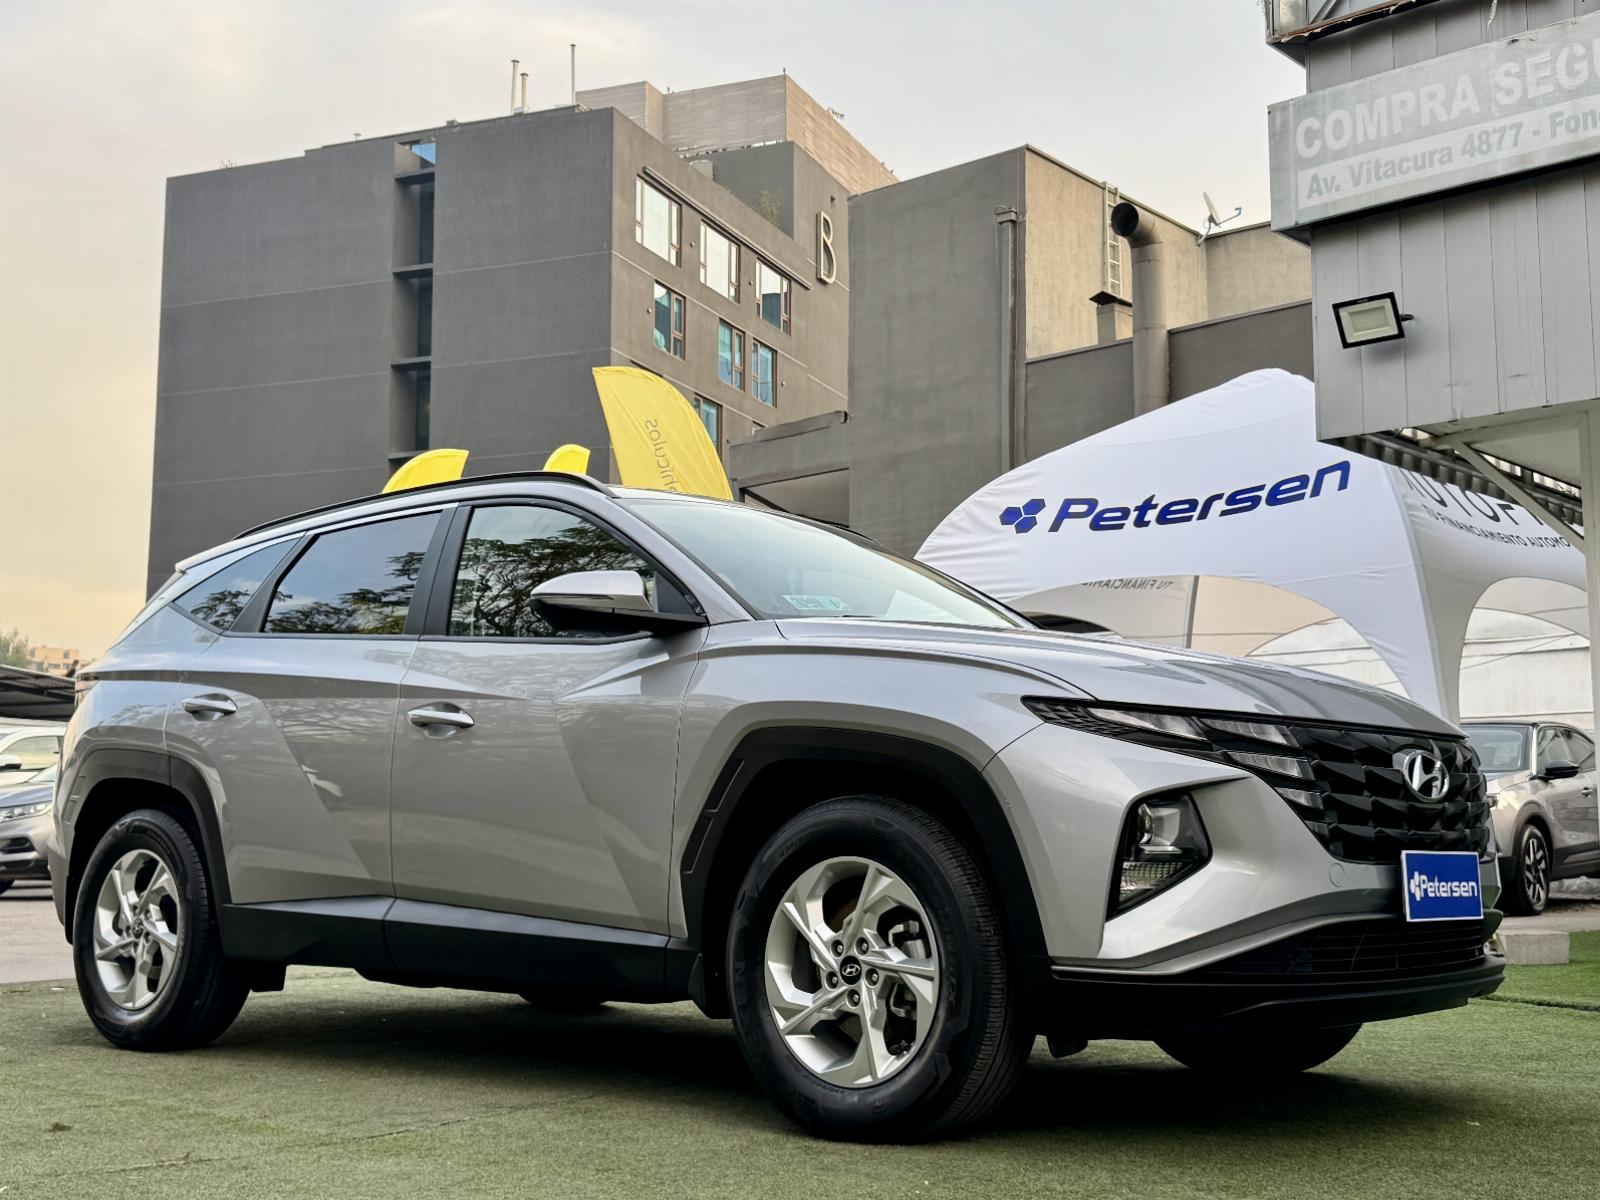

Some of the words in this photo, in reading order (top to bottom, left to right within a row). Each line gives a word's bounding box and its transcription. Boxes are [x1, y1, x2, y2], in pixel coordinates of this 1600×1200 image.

[1295, 74, 1481, 158] COMPRA
[1306, 173, 1341, 200] Av.
[1348, 143, 1453, 188] Vitacura
[1460, 121, 1523, 158] 4877
[1549, 109, 1600, 139] Fon
[817, 210, 837, 285] B
[1047, 459, 1351, 533] Petersen
[1436, 511, 1528, 547] FINANCIAMIENTO
[1419, 874, 1478, 898] Petersen
